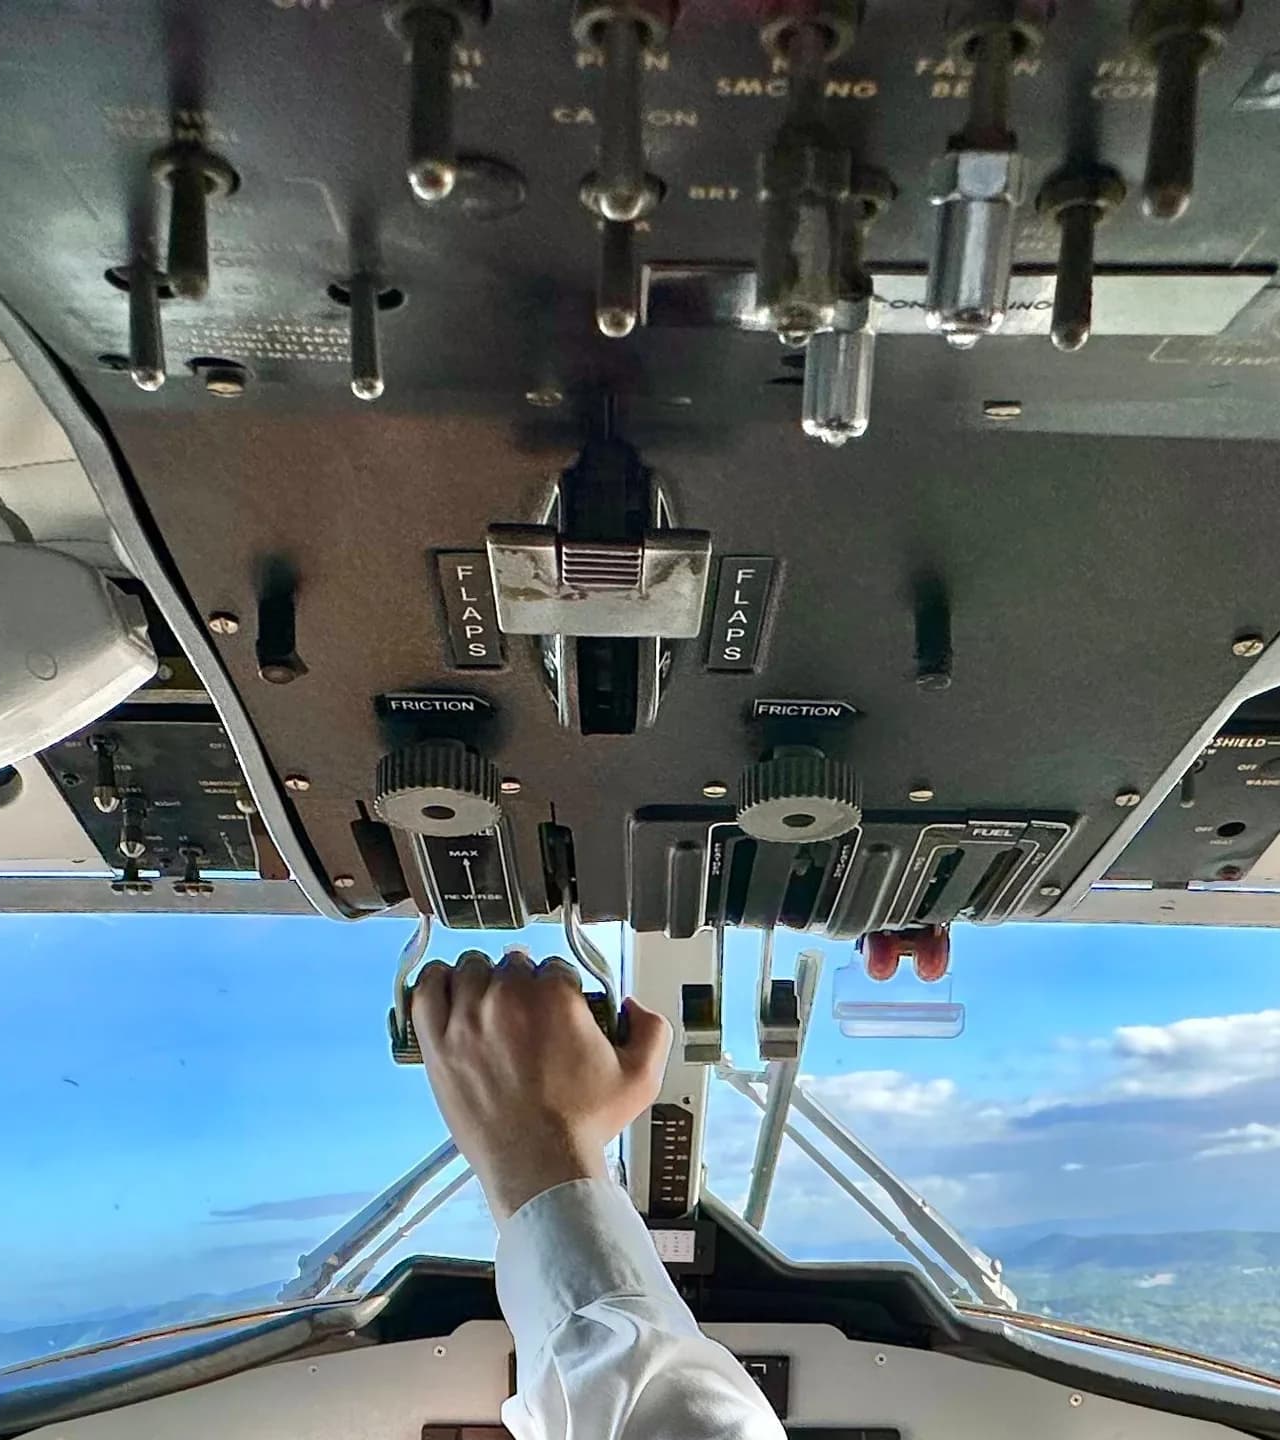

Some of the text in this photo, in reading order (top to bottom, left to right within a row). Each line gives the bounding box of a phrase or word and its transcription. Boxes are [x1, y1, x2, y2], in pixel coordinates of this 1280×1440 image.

[552, 107, 698, 127] CAON
[456, 564, 488, 658] FLAPS
[721, 568, 756, 662] FLAPS
[390, 699, 475, 712] FRICTION
[757, 703, 841, 718] FRICTION
[972, 827, 1013, 839] FUEL
[448, 850, 479, 858] MAX
[443, 892, 504, 901] REVERSE
